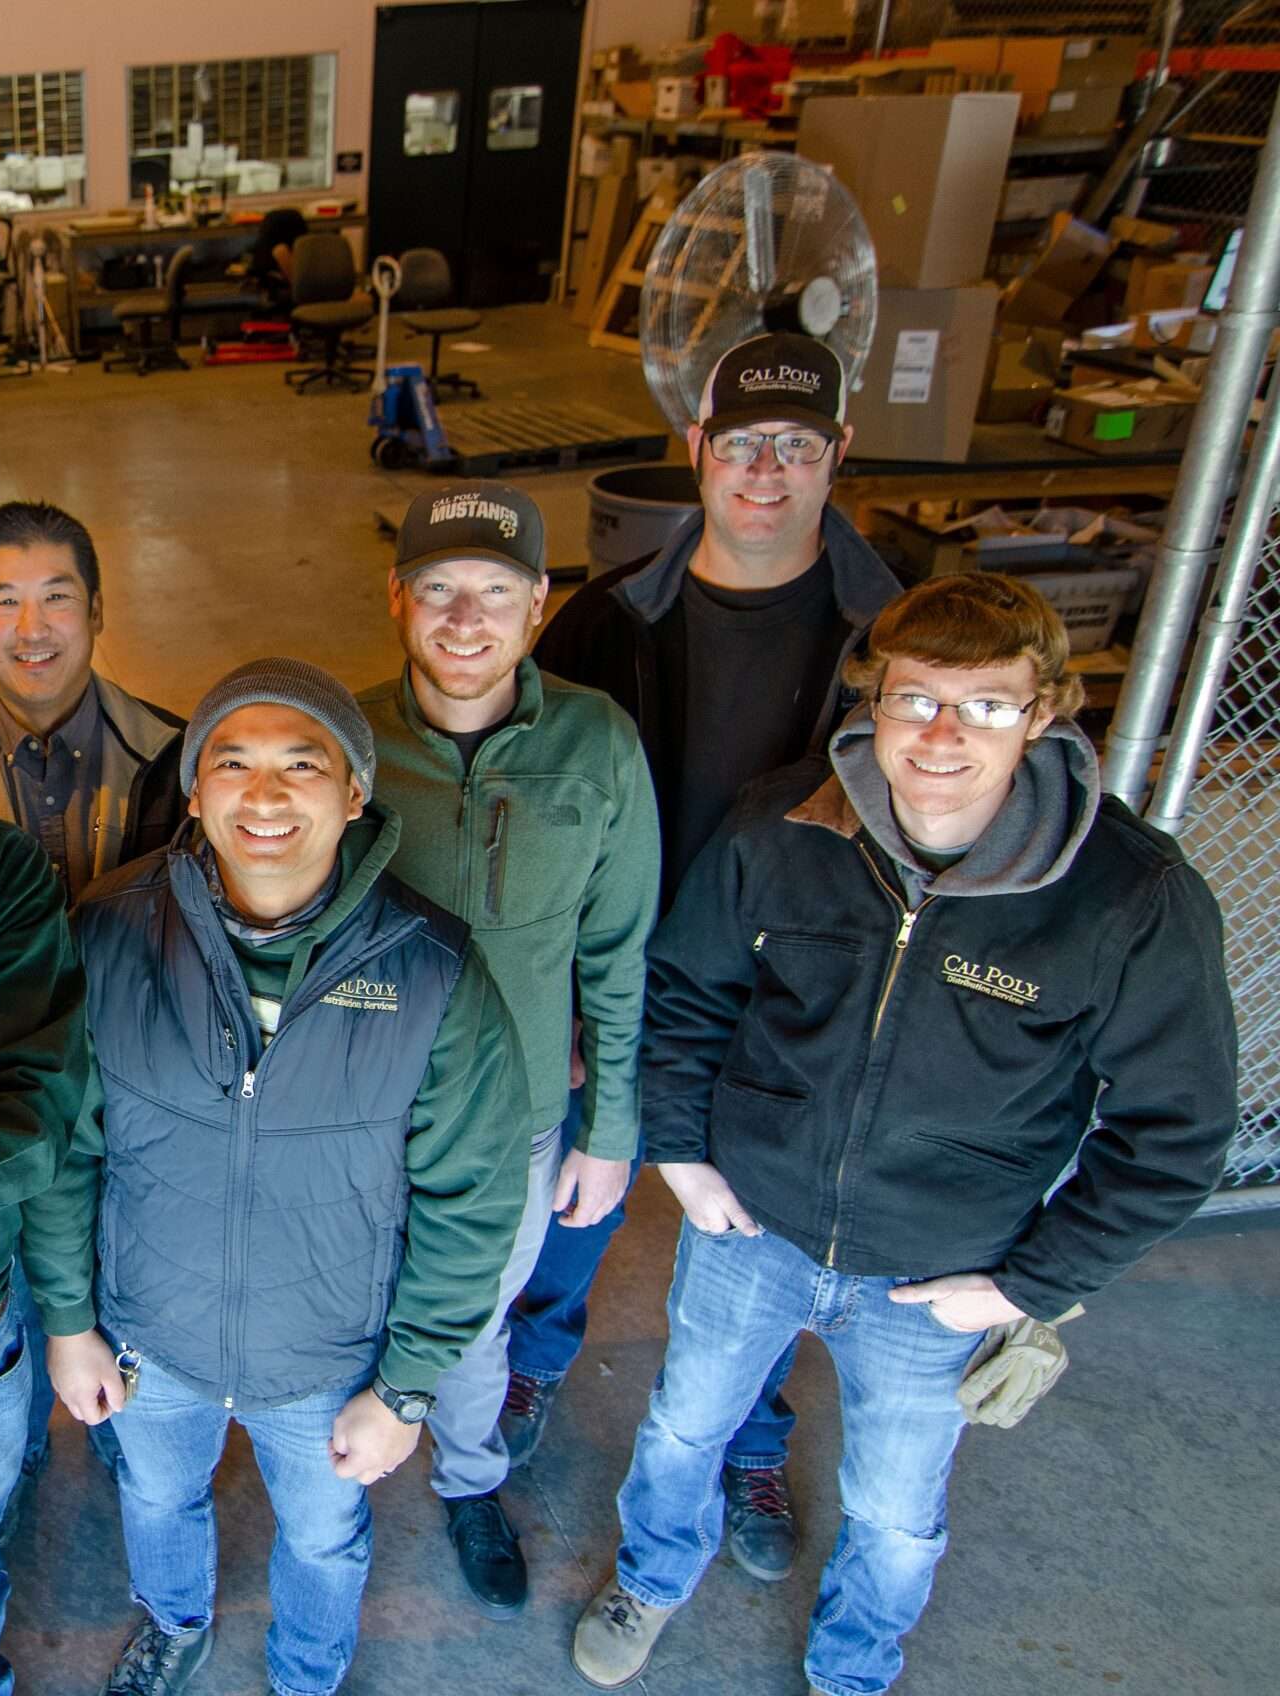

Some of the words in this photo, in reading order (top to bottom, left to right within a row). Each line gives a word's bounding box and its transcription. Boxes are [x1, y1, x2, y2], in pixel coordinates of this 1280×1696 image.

[740, 368, 775, 384] CAL
[432, 497, 452, 509] CAL
[453, 492, 480, 504] POLY
[430, 501, 518, 527] MUSTANGS
[944, 954, 981, 978] CAL
[336, 980, 355, 994] AL
[946, 975, 991, 995] Distribution
[991, 989, 1025, 1006] Services
[363, 1001, 398, 1012] Services
